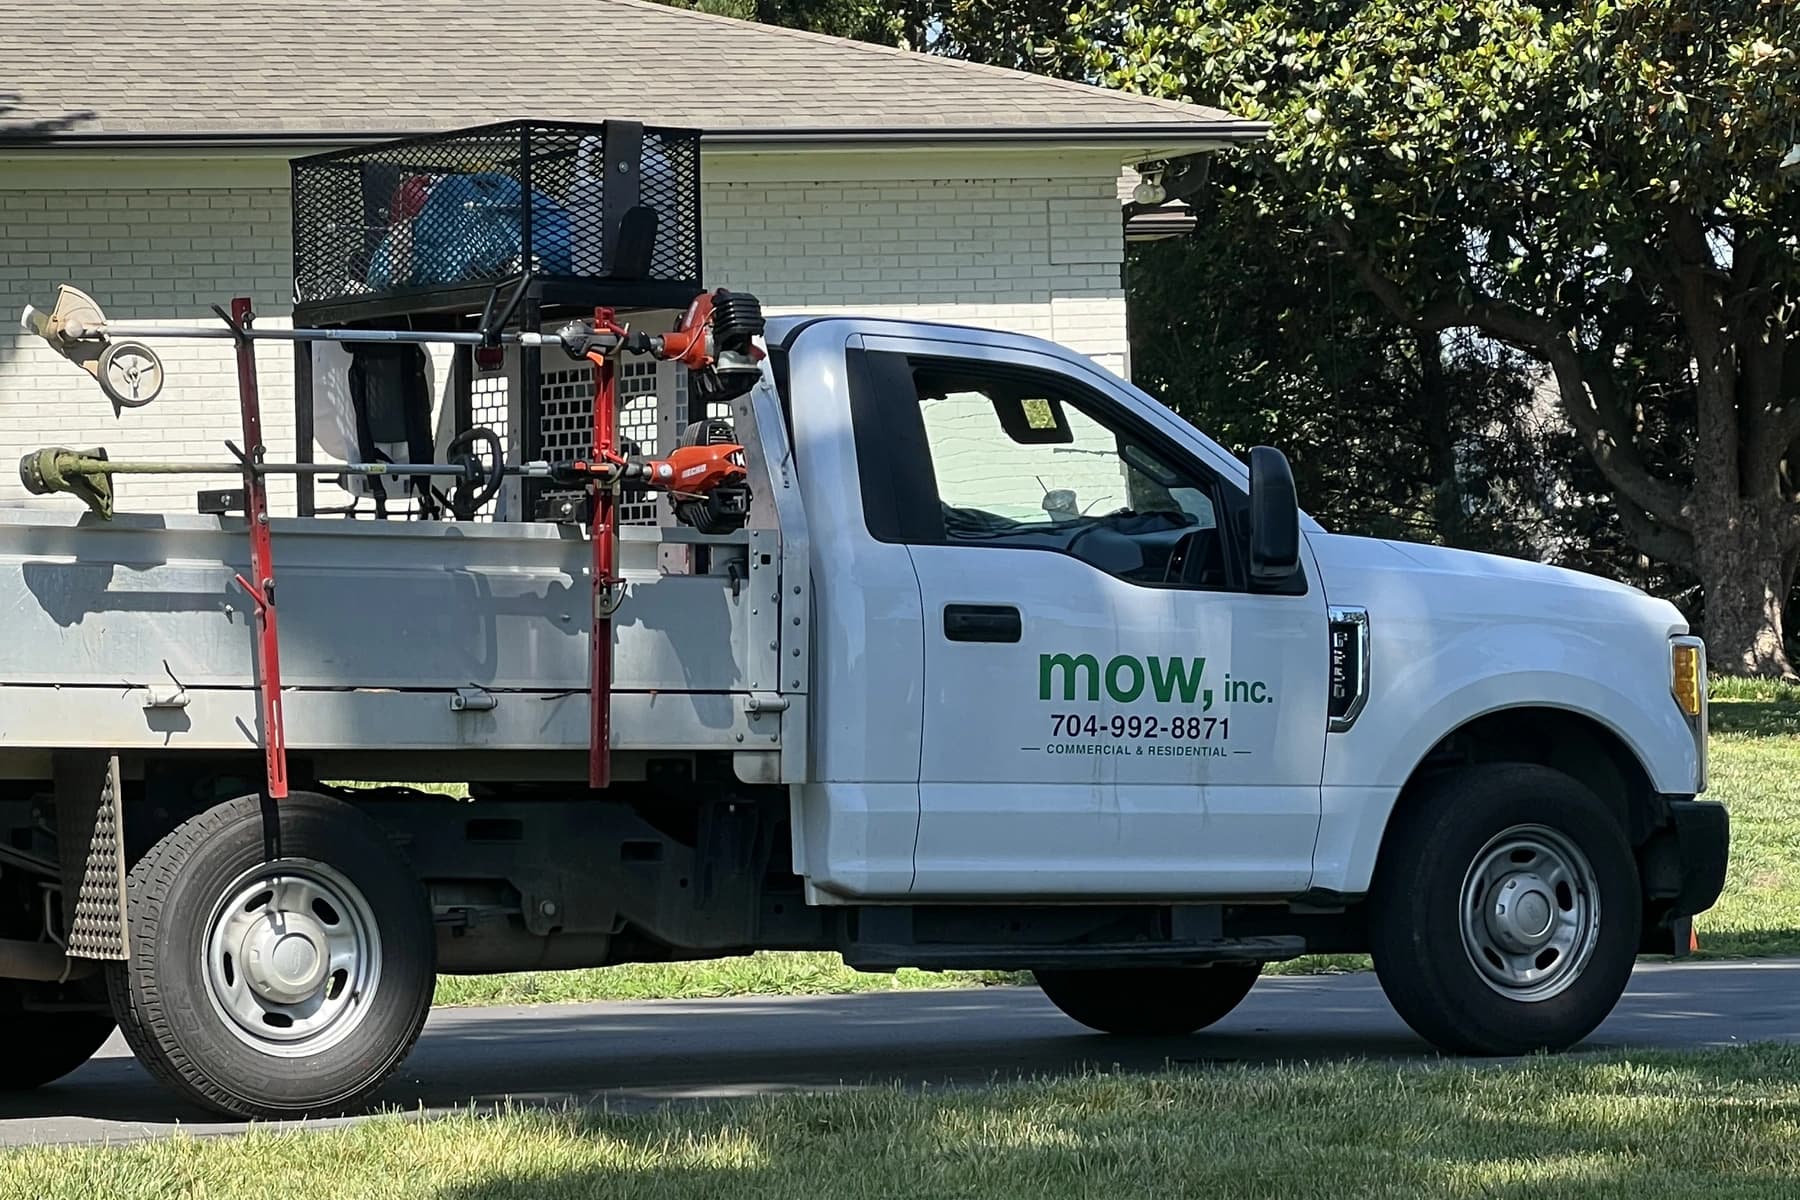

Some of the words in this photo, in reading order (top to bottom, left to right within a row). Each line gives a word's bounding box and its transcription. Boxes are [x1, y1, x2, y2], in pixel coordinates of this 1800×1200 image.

[1039, 653, 1214, 711] mow,
[1224, 673, 1274, 704] inc.
[1050, 714, 1229, 740] 704-992-8871
[1046, 744, 1132, 755] COMMERCIAL
[1136, 745, 1143, 756] &
[1148, 746, 1228, 758] RESIDENTIAL
